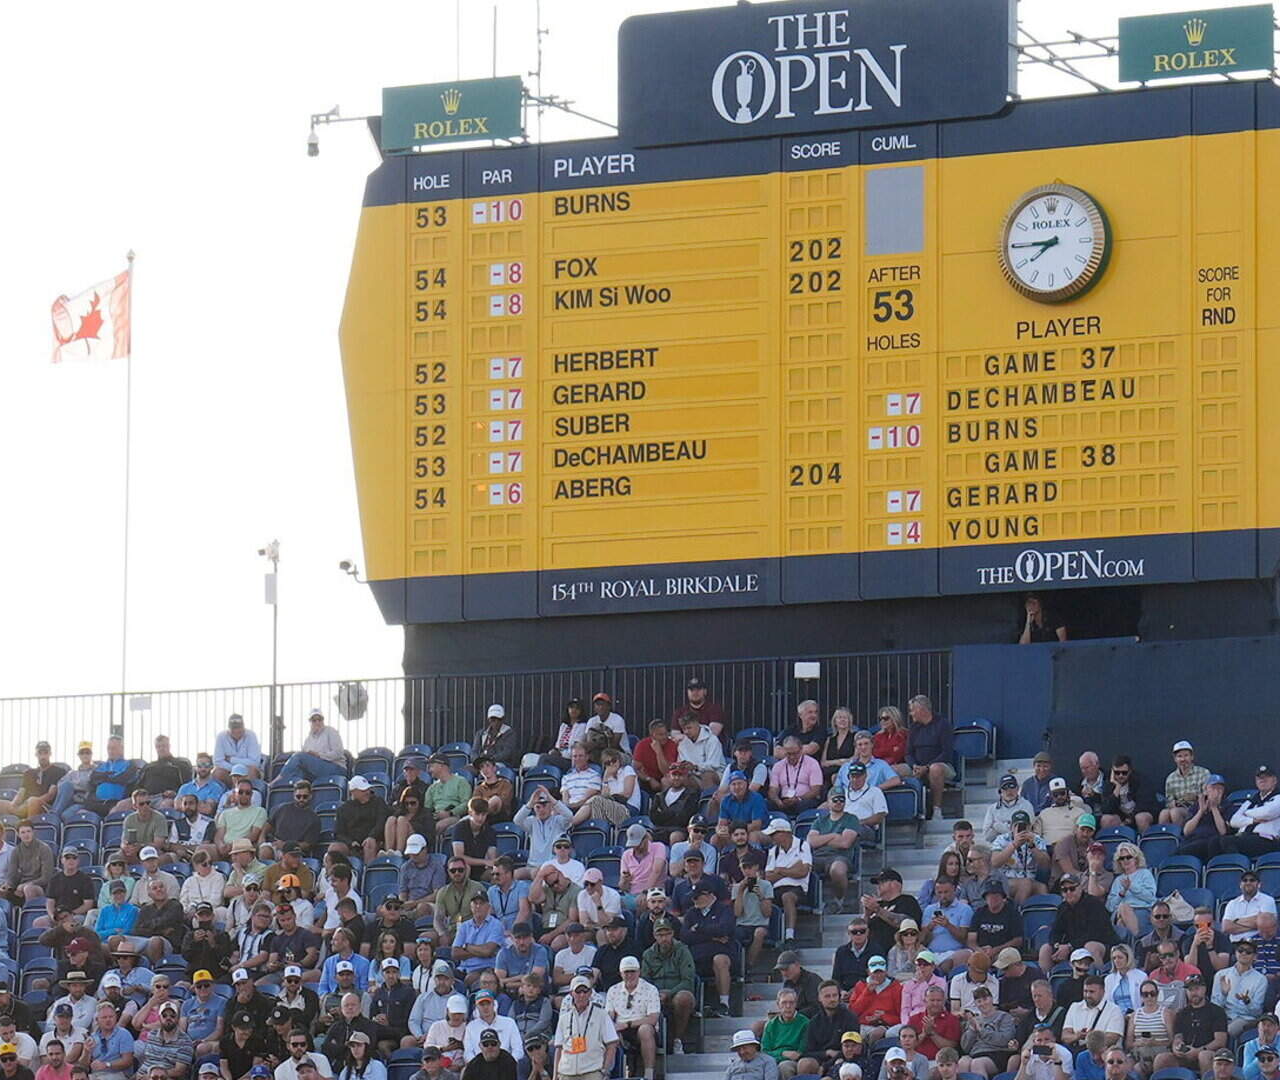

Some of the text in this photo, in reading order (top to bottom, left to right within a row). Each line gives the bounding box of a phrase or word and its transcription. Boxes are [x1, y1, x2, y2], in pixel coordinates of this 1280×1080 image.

[768, 10, 850, 51] THE
[1153, 48, 1238, 72] ROLEX
[712, 44, 907, 123] OPEN
[414, 117, 488, 138] ROLEX
[792, 142, 840, 158] SCORE
[872, 136, 916, 151] CUML
[555, 154, 634, 177] PLAYER
[414, 175, 449, 190] HOLE
[483, 169, 511, 184] PAR
[475, 200, 522, 222] -10
[554, 191, 630, 216] BURNS
[418, 207, 446, 227] 53
[1032, 218, 1071, 230] ROLEX
[791, 238, 840, 261] 202
[492, 263, 522, 284] -8
[555, 258, 597, 278] FOX
[869, 266, 920, 282] AFTER
[1199, 267, 1238, 282] SCORE
[417, 269, 446, 289] 54
[790, 271, 840, 293] 202
[556, 285, 670, 309] KIM Si Woo
[1207, 287, 1230, 301] FOR
[417, 300, 446, 321] 54
[492, 295, 522, 315] -8
[874, 289, 914, 322] 53
[1203, 307, 1235, 325] RND
[1017, 317, 1100, 339] PLAYER
[868, 333, 920, 350] HOLES
[492, 358, 522, 378] -7
[555, 348, 658, 373] HERBERT
[985, 346, 1115, 375] GAME 37
[416, 363, 445, 384] 52
[492, 389, 522, 409] -7
[554, 381, 645, 404] GERARD
[889, 392, 921, 414] -7
[948, 379, 1134, 410] DECHAMBEAU
[416, 394, 445, 415] 53
[492, 420, 522, 441] -7
[556, 413, 629, 436] SUBER
[949, 418, 1037, 443] BURNS
[416, 426, 445, 446] 52
[871, 426, 920, 448] -10
[492, 452, 522, 472] -7
[555, 440, 706, 467] DeCHAMBEAU
[986, 445, 1115, 473] GAME 38
[416, 457, 444, 477] 53
[791, 463, 841, 486] 204
[492, 483, 522, 504] -6
[555, 476, 630, 499] ABERG
[948, 482, 1057, 508] GERARD
[416, 488, 445, 509] 54
[889, 490, 921, 511] -7
[889, 522, 921, 543] -4
[949, 516, 1039, 540] YOUNG
[553, 574, 760, 600] 154TH ROYAL BIRKDALE
